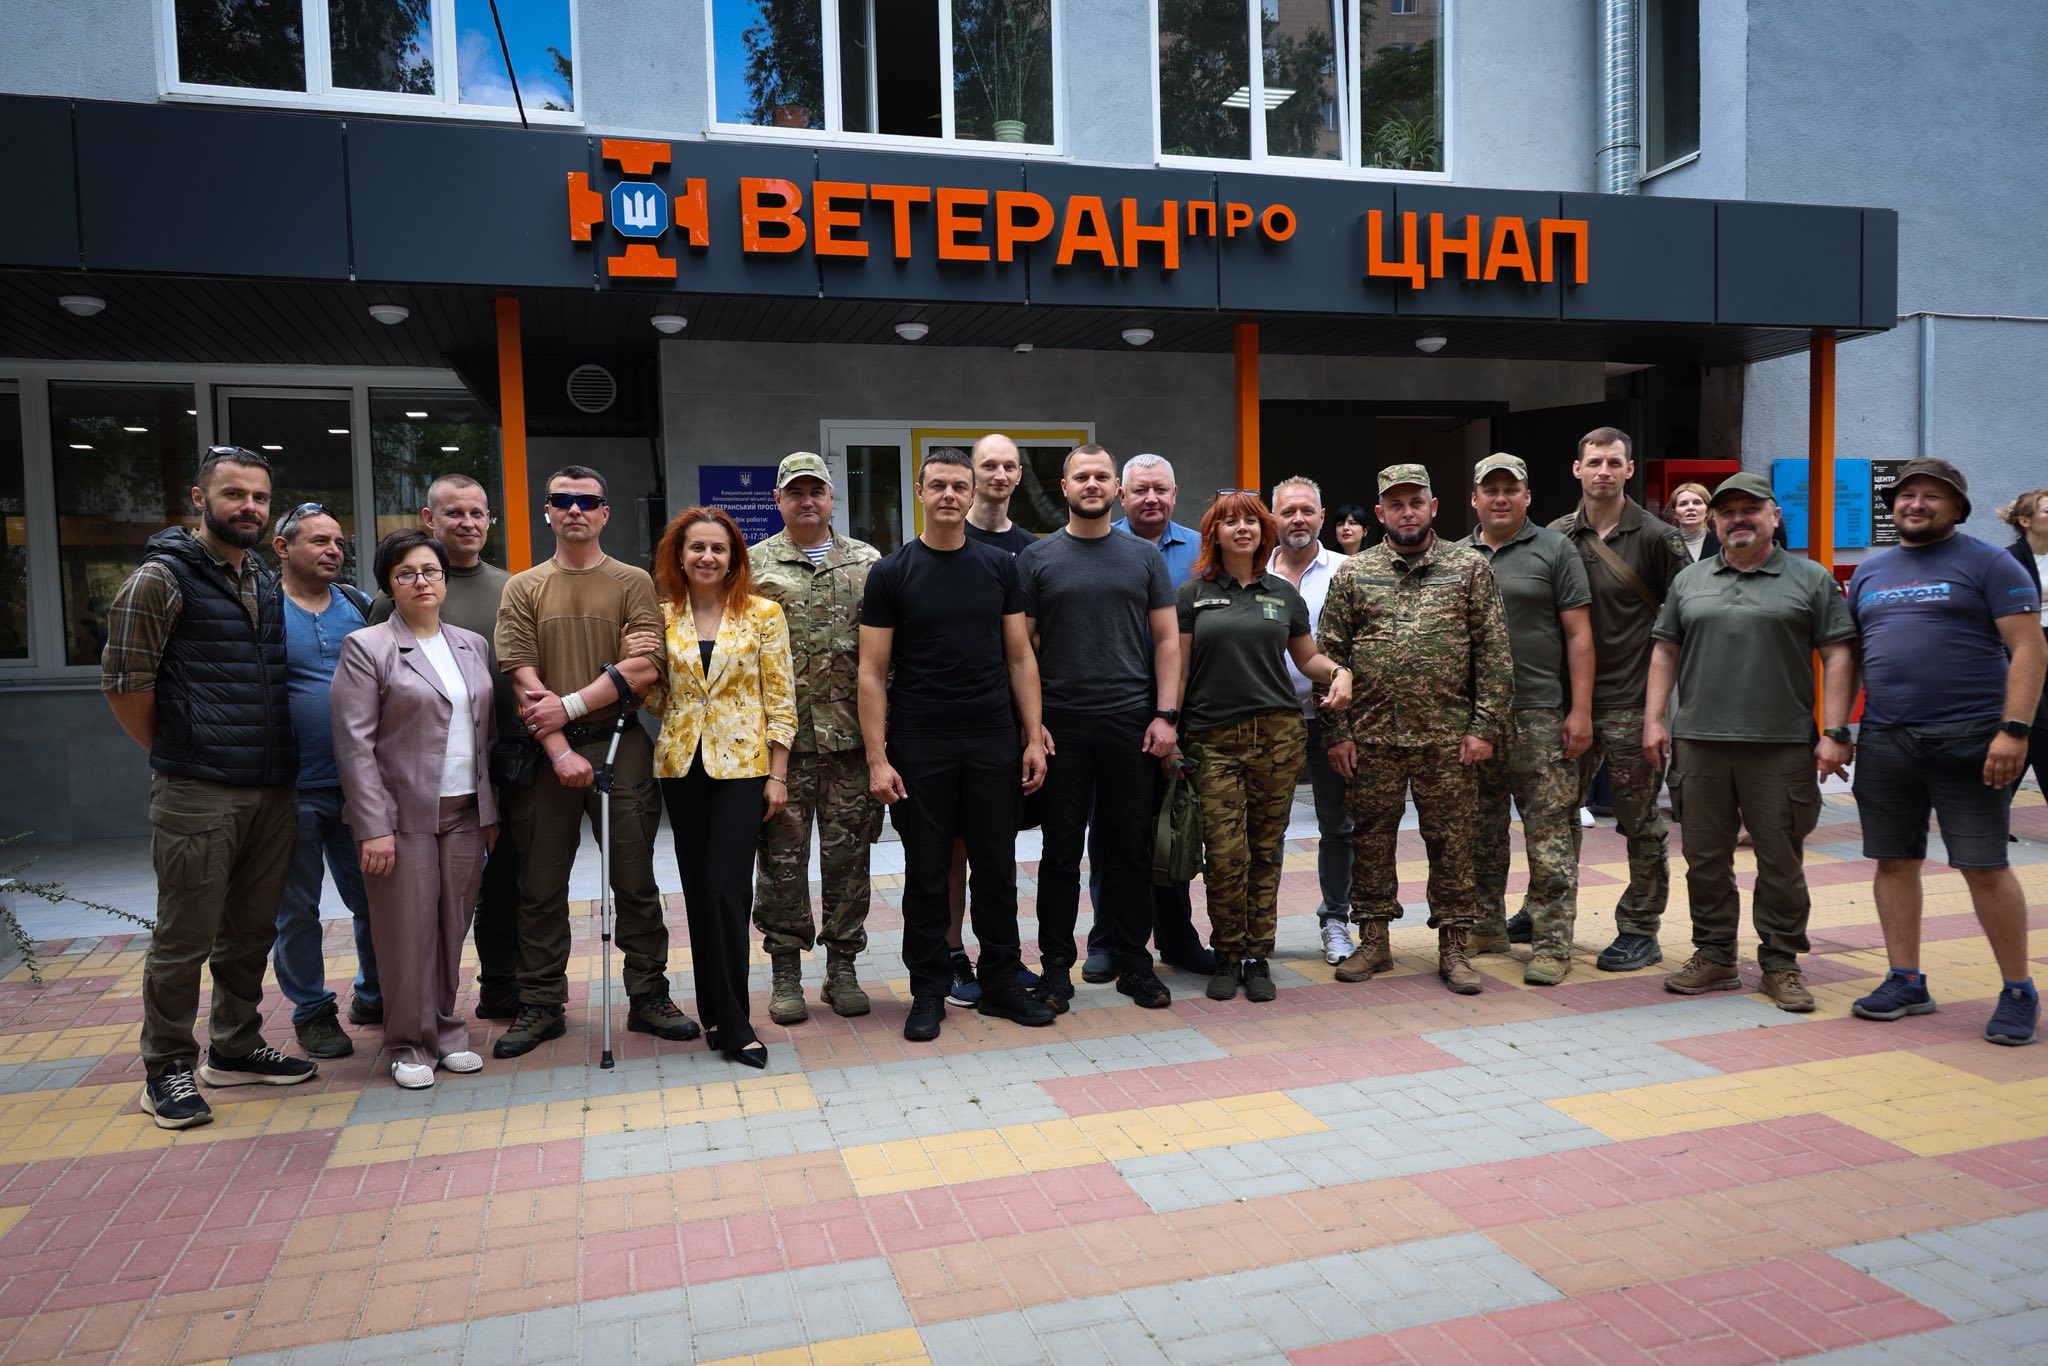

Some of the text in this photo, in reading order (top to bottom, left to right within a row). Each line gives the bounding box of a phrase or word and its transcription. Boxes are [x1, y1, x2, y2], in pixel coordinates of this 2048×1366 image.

[740, 177, 1589, 290] ВЕТЕРАН ПРО ЦНАП
